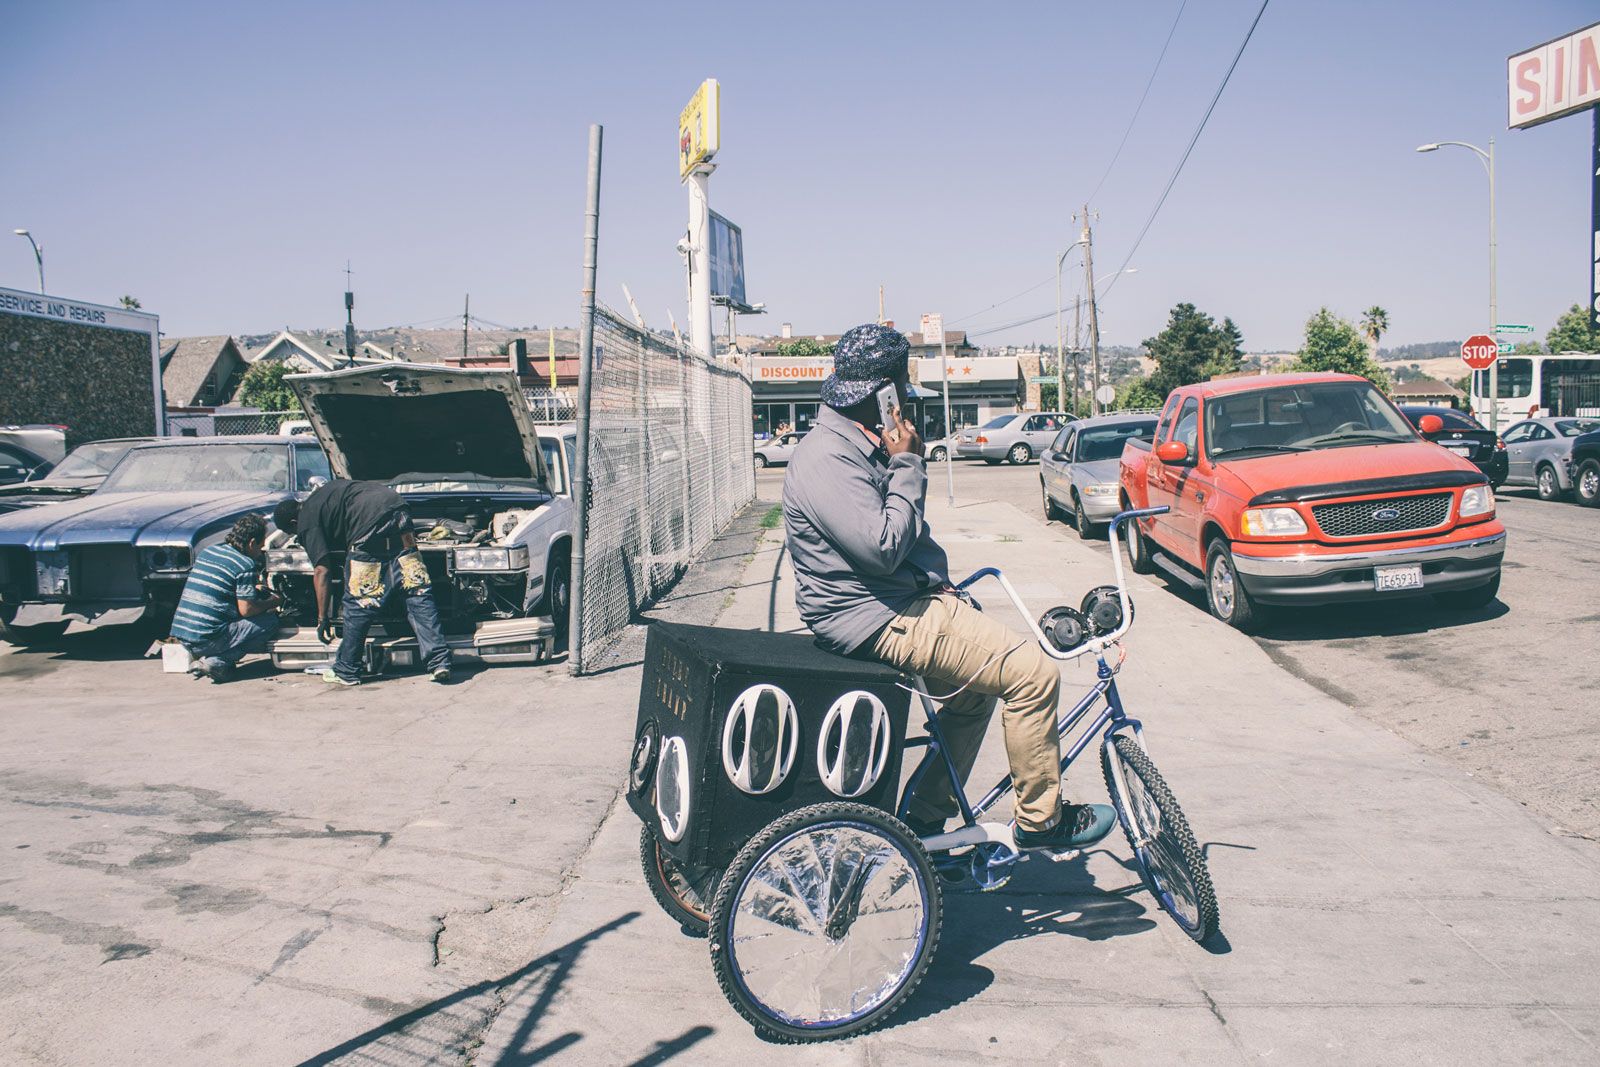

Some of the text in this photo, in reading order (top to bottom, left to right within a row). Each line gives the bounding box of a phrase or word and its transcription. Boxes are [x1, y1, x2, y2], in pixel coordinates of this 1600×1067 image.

[47, 303, 65, 317] AND
[70, 306, 106, 323] REPAIRS
[1463, 345, 1496, 360] STOP
[761, 367, 824, 378] DISCOUNT
[1378, 572, 1418, 587] 7E65931
